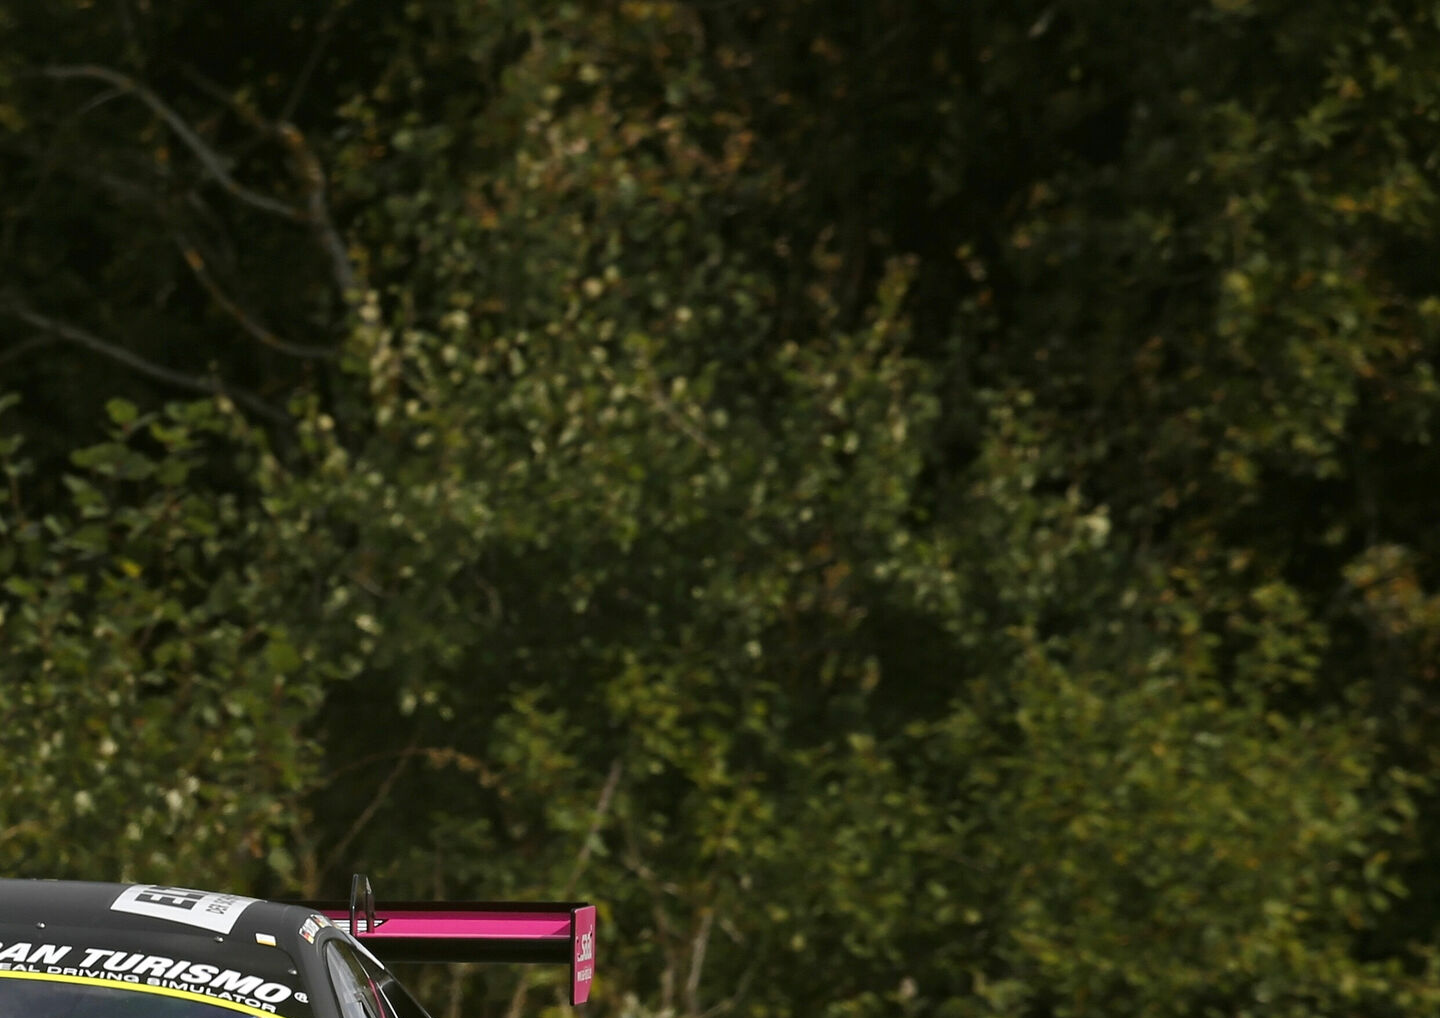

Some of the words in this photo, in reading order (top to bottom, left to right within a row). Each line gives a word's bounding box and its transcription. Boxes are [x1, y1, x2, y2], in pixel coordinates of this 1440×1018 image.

[46, 966, 140, 984] DRIVING
[146, 977, 277, 1014] SIMULATOR
[79, 948, 292, 1004] TURISMO
